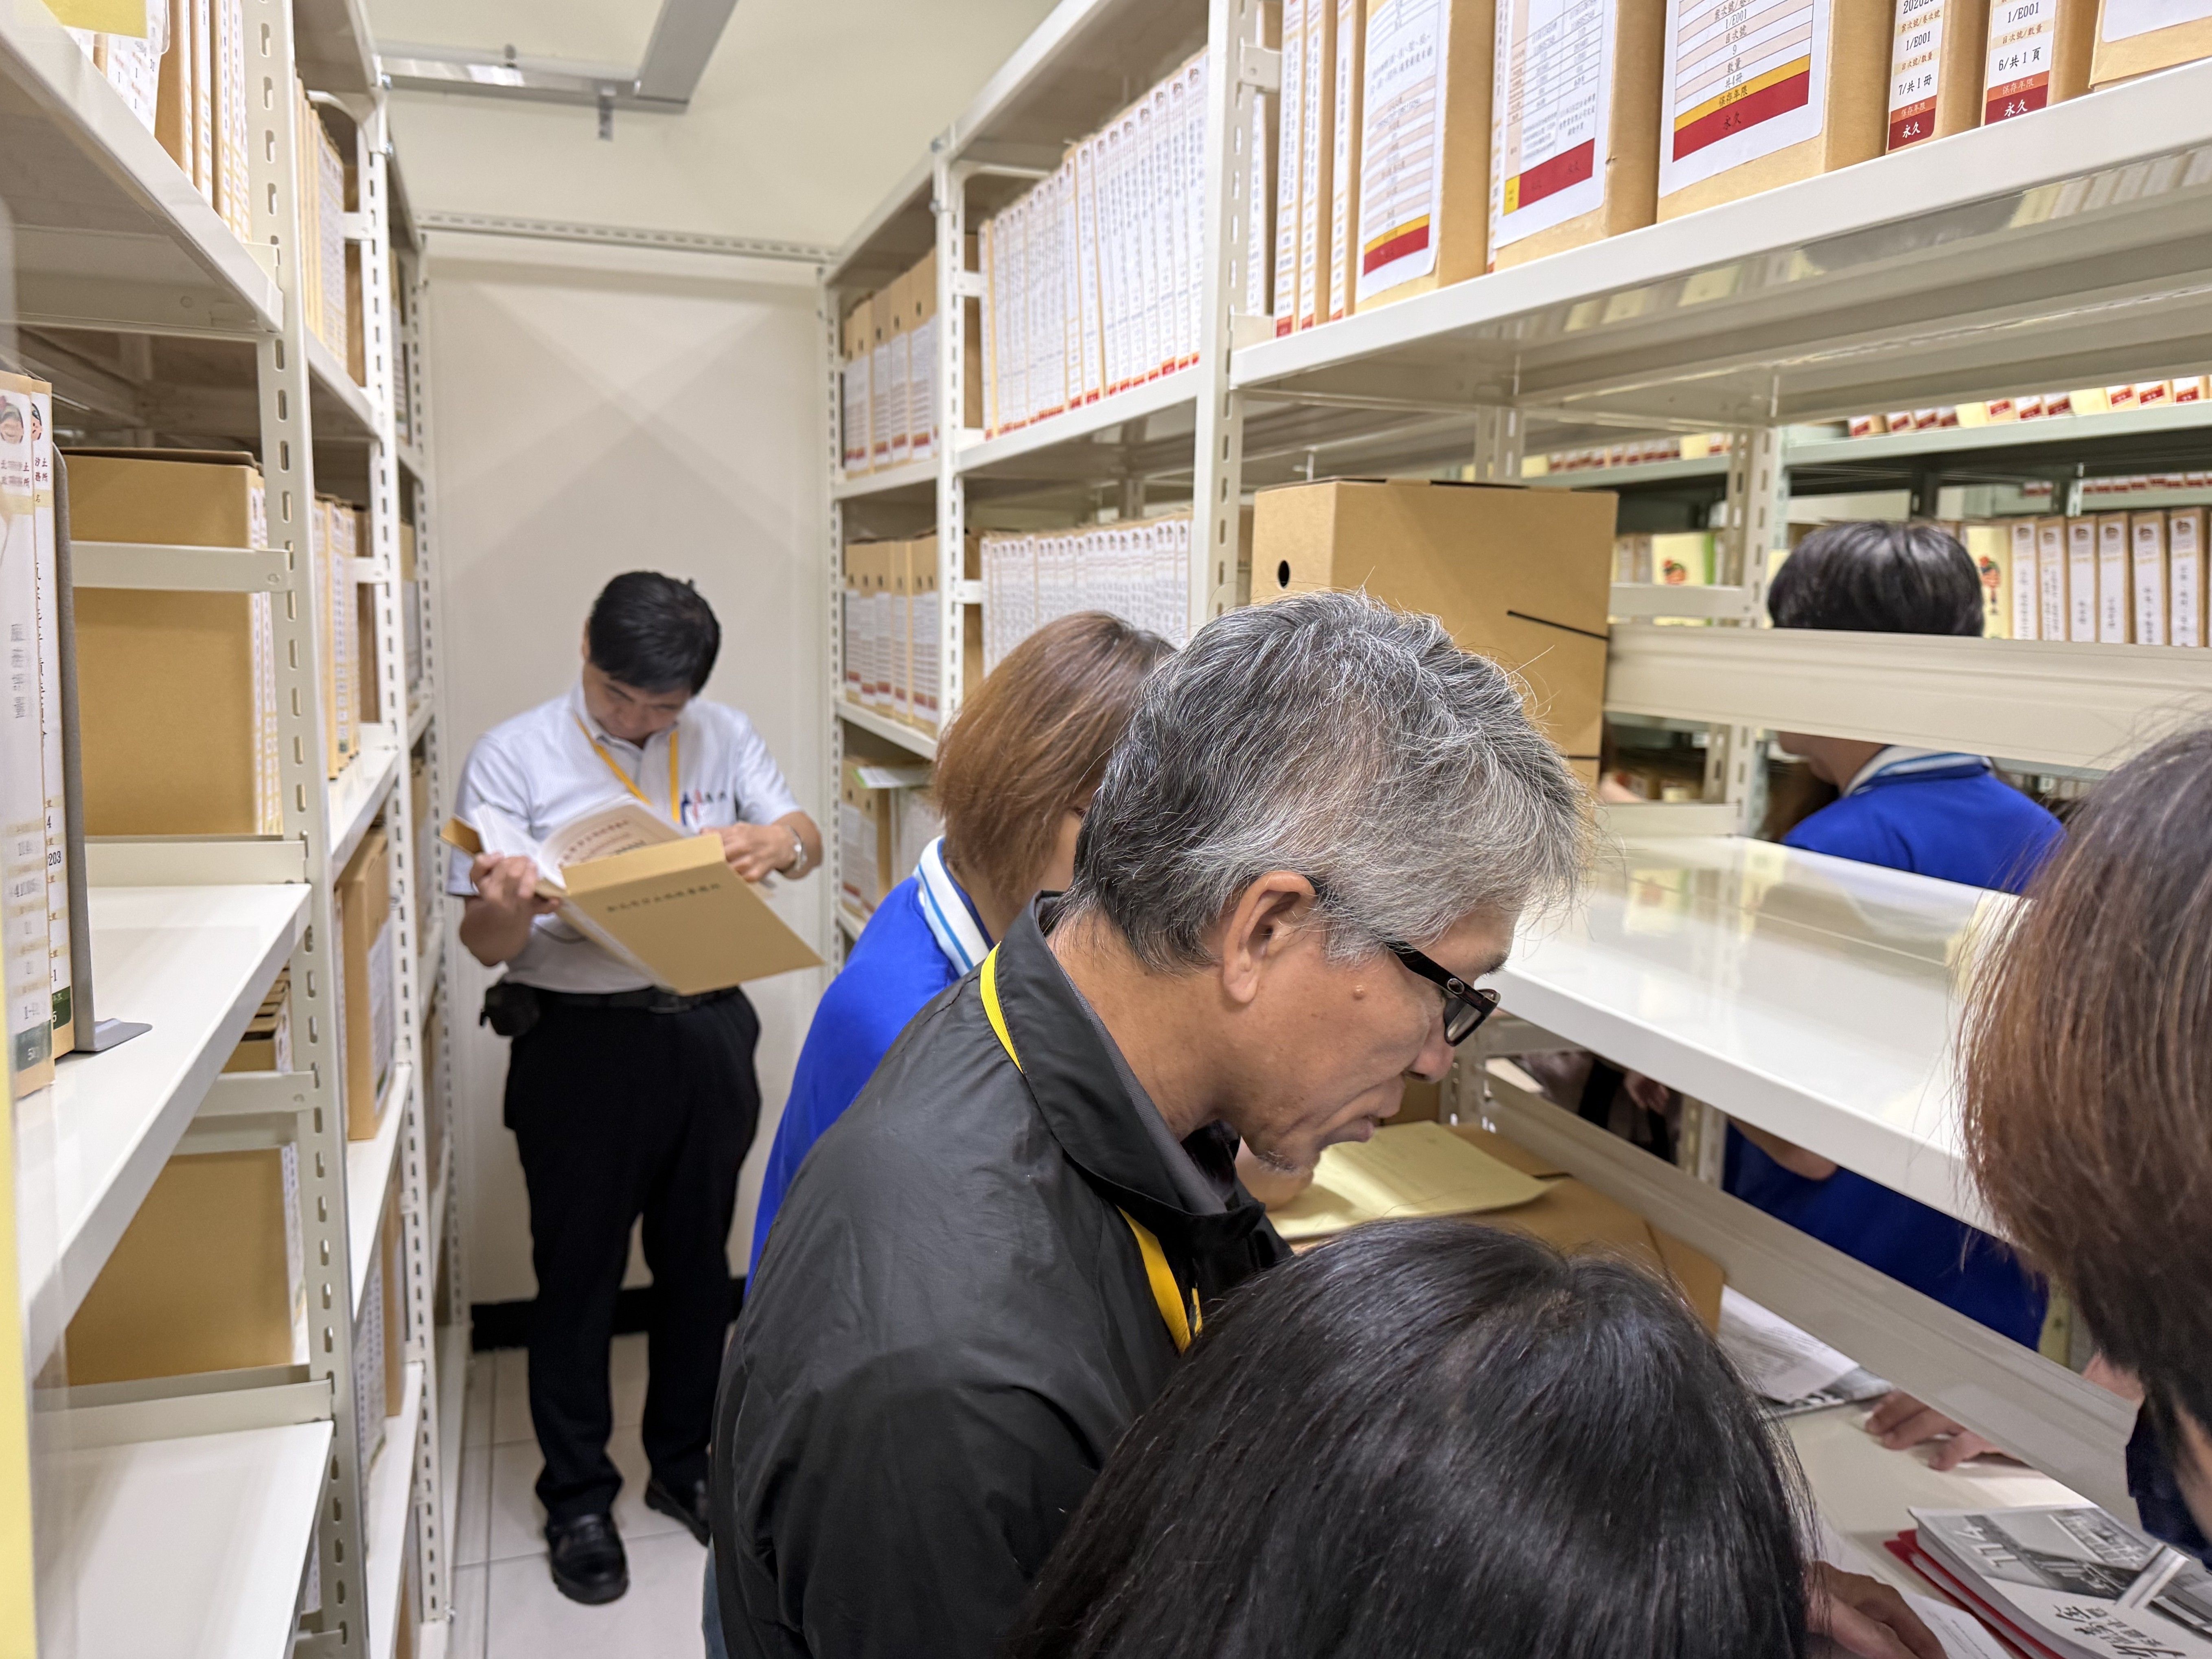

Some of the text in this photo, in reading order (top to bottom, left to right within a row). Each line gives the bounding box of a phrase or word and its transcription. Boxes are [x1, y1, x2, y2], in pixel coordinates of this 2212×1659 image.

[1726, 9, 1747, 29] 1/E001
[2008, 2, 2039, 23] 1/E001
[1726, 25, 1747, 44] 目次號
[1906, 31, 1930, 51] 1/E001
[2003, 23, 2042, 44] 目次號/數量
[1733, 44, 1737, 55] 9
[1728, 57, 1741, 73] 數量
[1719, 85, 1748, 107] 保存年限
[2002, 78, 2034, 95] 保存年限
[1901, 102, 1926, 117] 保存年限
[2004, 99, 2028, 117] 永久
[1724, 111, 1741, 130] 永久
[1902, 122, 1921, 138] 永久
